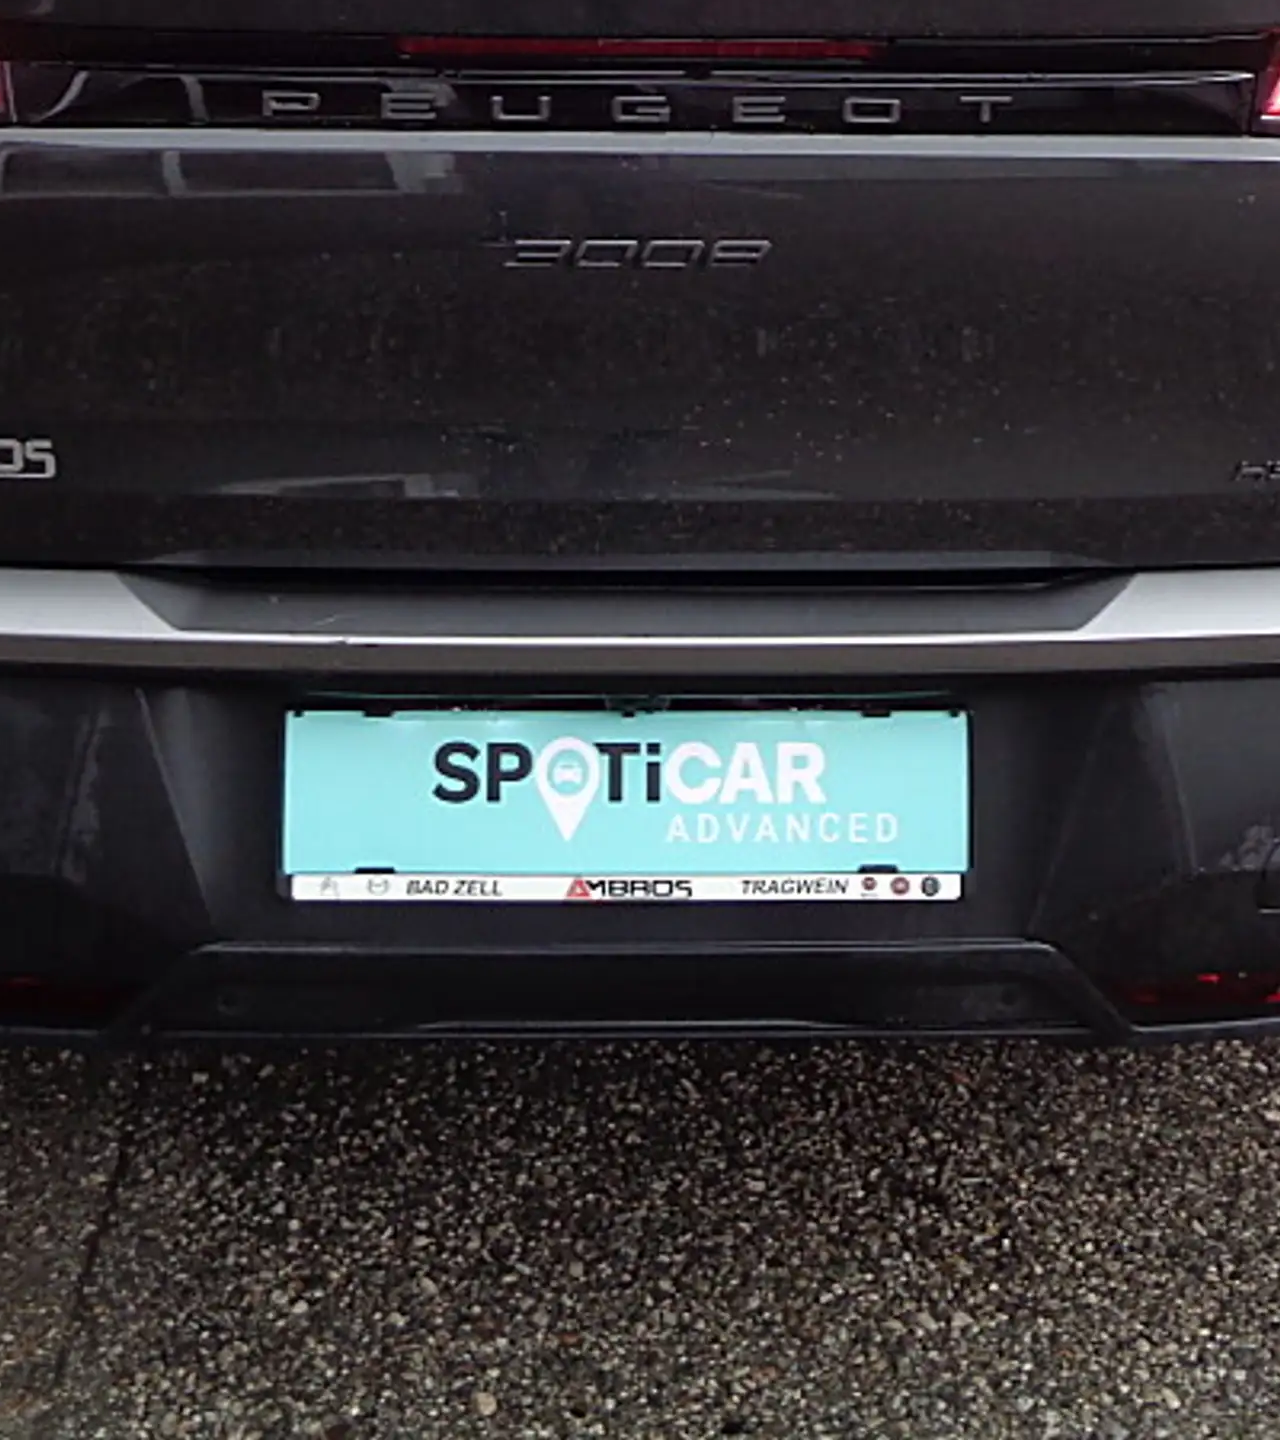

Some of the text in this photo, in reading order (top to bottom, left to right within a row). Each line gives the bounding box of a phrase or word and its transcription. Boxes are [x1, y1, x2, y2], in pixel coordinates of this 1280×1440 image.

[262, 90, 1012, 124] PEUGEOT
[667, 814, 898, 843] ADVANCED
[406, 875, 849, 898] BAD ZELL AMBROS TRAGWEIN
